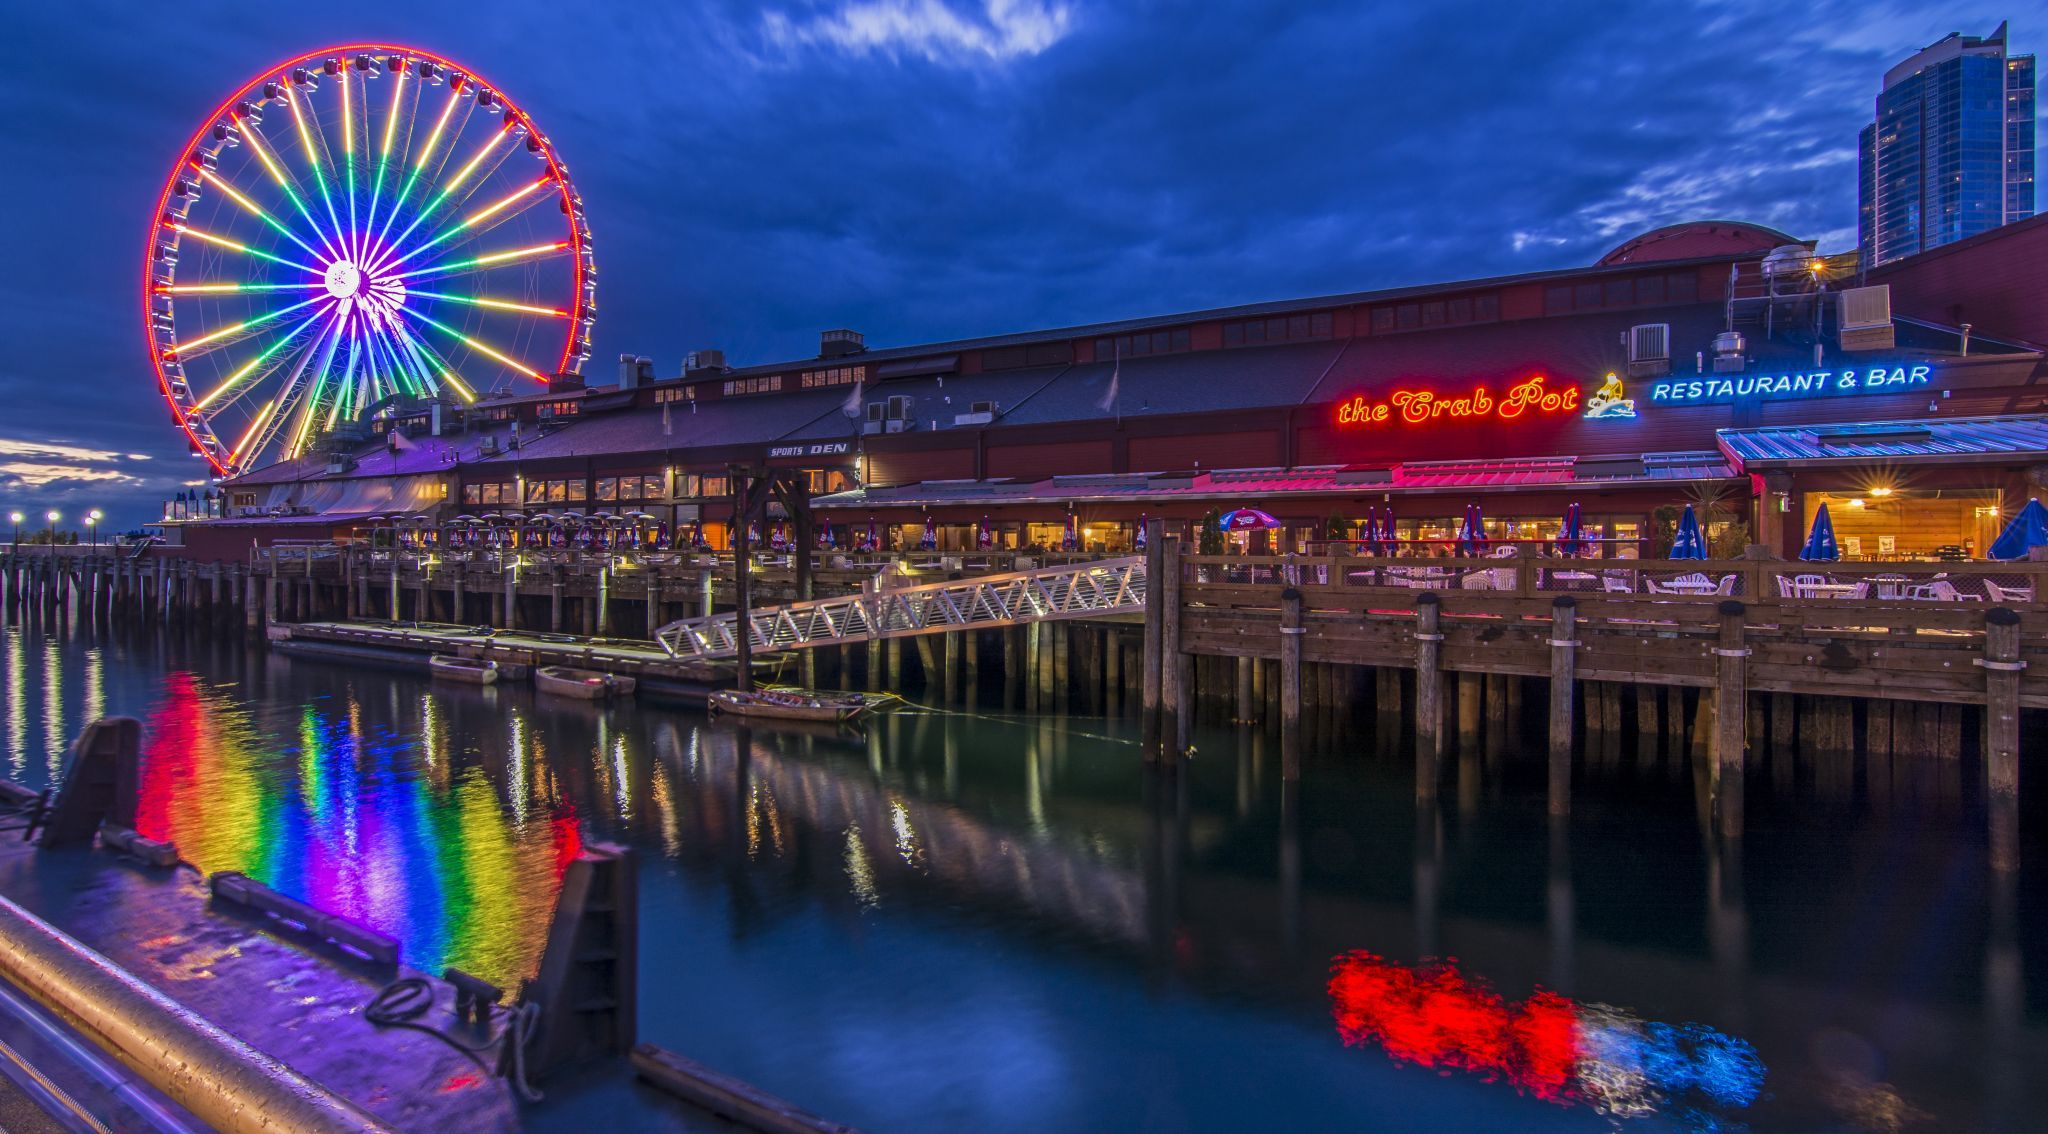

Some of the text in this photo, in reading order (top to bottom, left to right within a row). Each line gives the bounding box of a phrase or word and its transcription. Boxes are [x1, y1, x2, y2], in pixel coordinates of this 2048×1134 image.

[1338, 376, 1578, 424] the Crab Pot
[1652, 365, 1931, 401] RESTAURANT & BAR
[770, 443, 847, 457] SPORTS DEN
